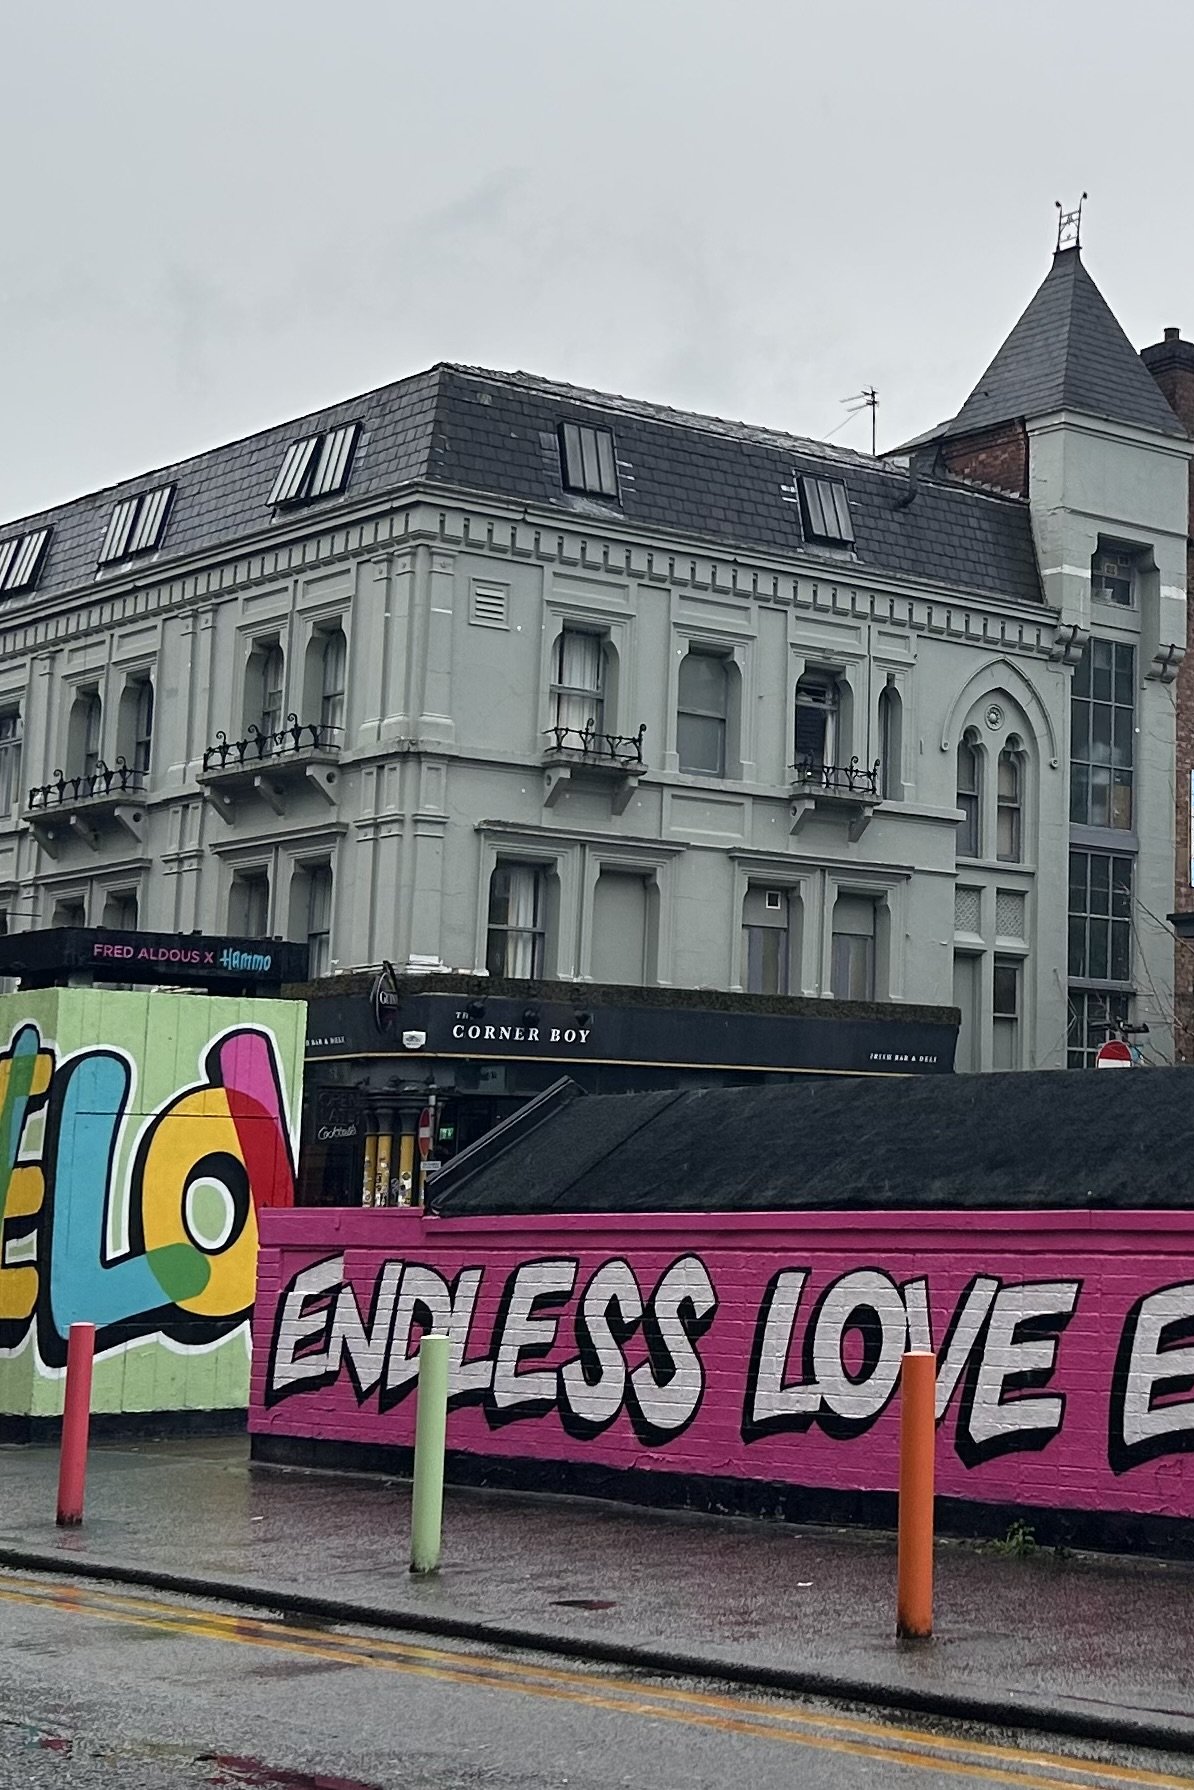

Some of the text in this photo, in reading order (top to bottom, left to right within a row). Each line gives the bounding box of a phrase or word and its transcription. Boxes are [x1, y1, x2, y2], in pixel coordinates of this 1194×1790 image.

[93, 944, 133, 958] FRED
[138, 947, 200, 963] ALDOUS
[204, 951, 214, 963] X
[452, 1025, 591, 1043] CORNER BOY
[894, 1054, 909, 1062] BAR
[919, 1055, 937, 1063] DELI
[264, 1251, 718, 1447] ENDLESS
[741, 1266, 1085, 1469] LOVE
